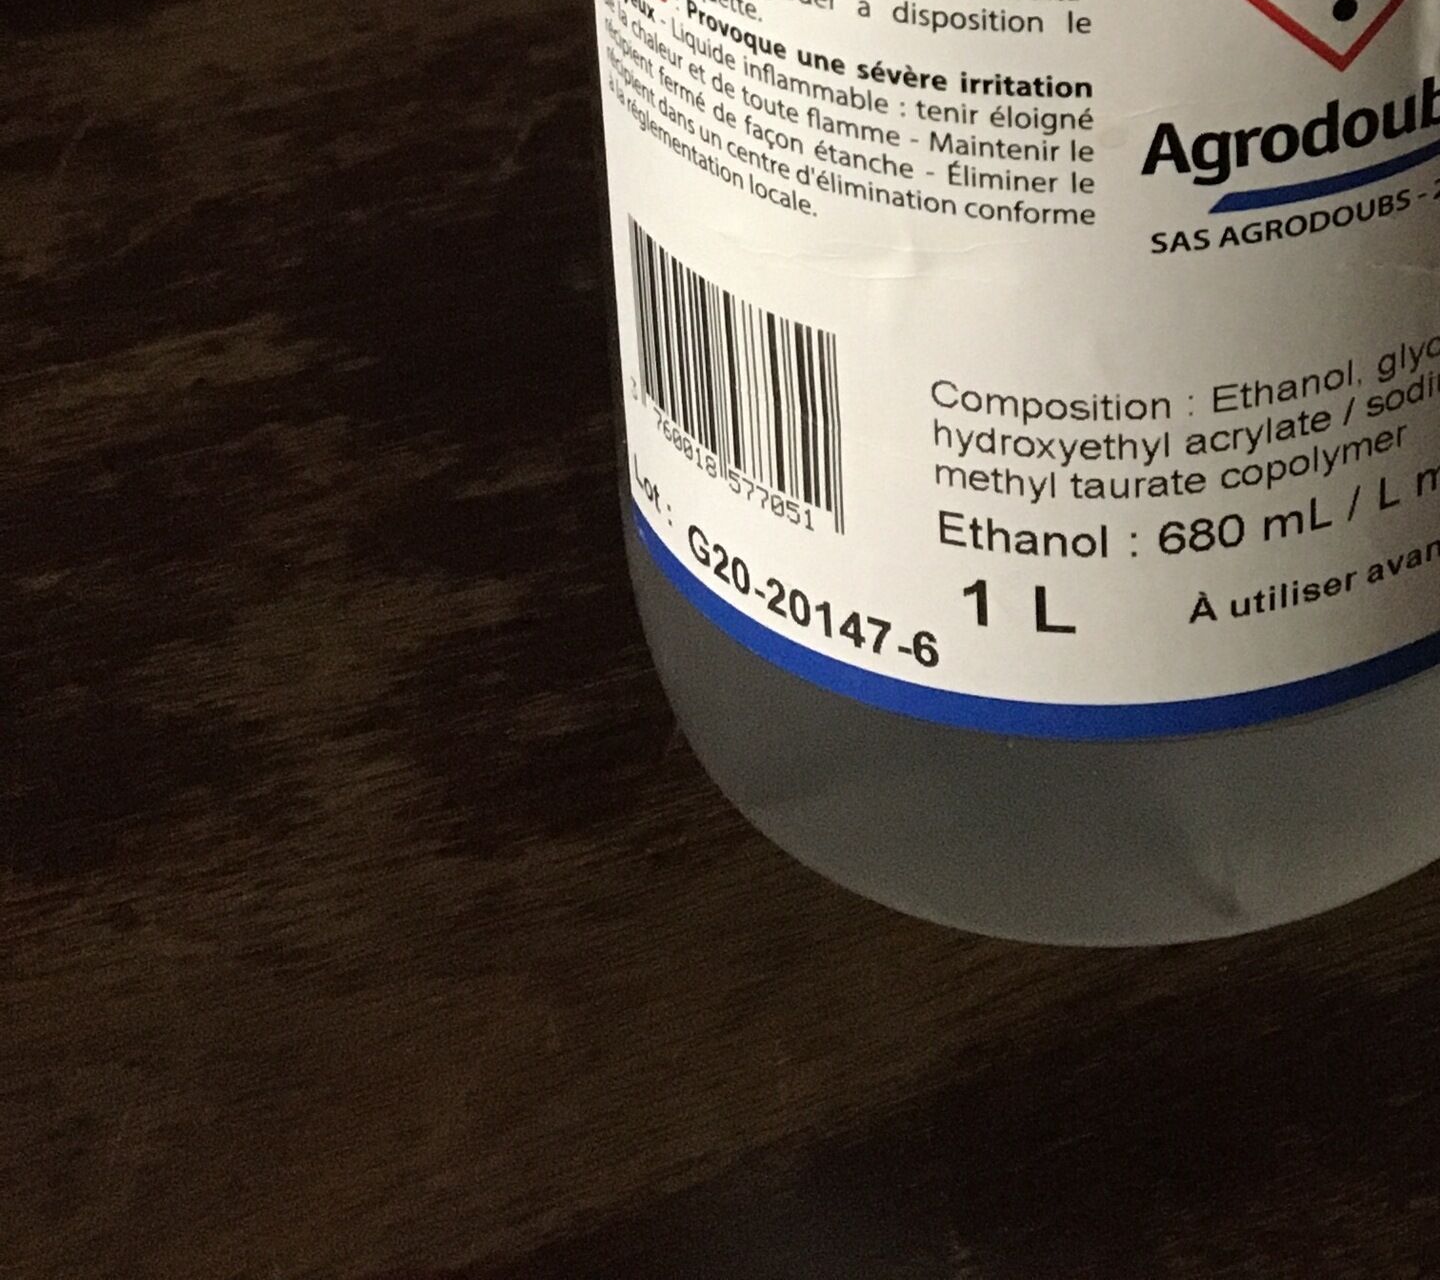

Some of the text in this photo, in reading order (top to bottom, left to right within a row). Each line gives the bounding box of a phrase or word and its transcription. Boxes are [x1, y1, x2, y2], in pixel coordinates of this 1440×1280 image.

[687, 0, 787, 60] Provoque
[798, 51, 846, 74] une
[856, 63, 947, 91] sévère
[961, 71, 1093, 98] irritation
[892, 1, 1044, 34] disposition
[1068, 11, 1092, 34] le
[672, 17, 1094, 135] Liquide inflammable tenir éloigné
[742, 86, 1095, 162] toute flamme Maintenir le
[744, 115, 1095, 194] façon étanche Éliminer le
[727, 139, 1095, 225] centre d'élimination conforme
[749, 172, 818, 218] locale.
[1151, 228, 1211, 254] SAS
[1218, 189, 1411, 248] AGRODOUBS
[931, 380, 1171, 423] Composition
[1213, 361, 1363, 415] Ethanol,
[934, 419, 1170, 467] hydroxyethyl
[1186, 408, 1332, 457] acrylate
[936, 421, 1408, 504] methyl taurate copolymer
[939, 510, 1109, 559] Ethanol
[1159, 513, 1246, 556] 680
[1263, 495, 1332, 543] mL
[1378, 476, 1400, 510] L
[688, 524, 939, 668] G20-20147-6
[964, 580, 1076, 634] 1 L
[1189, 590, 1218, 623] À
[1231, 568, 1357, 619] utiliser
